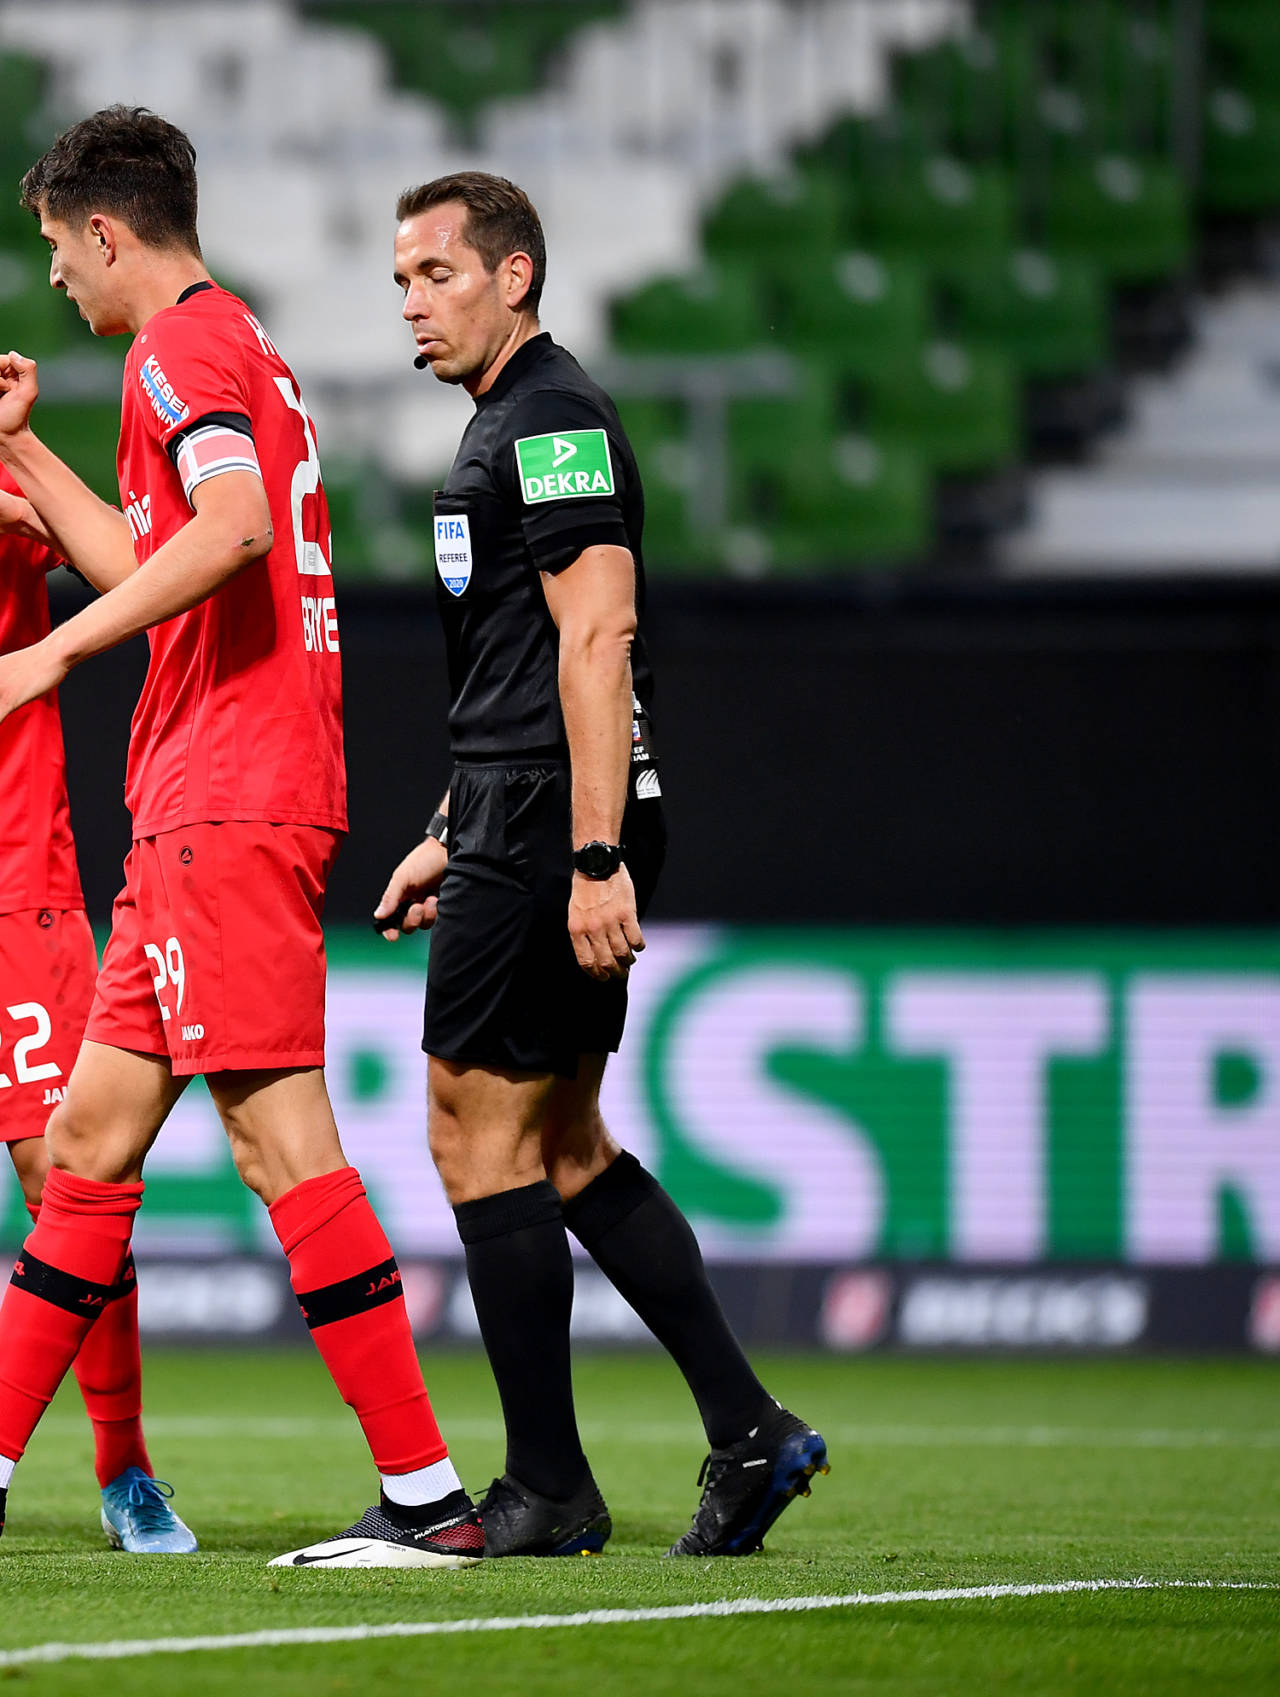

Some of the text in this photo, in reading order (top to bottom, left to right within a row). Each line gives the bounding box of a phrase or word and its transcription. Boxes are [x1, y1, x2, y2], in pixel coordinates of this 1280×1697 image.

[139, 370, 178, 433] TRAININ
[272, 377, 333, 575] 2
[525, 470, 610, 498] DEKRA
[437, 521, 465, 539] FIFA
[439, 552, 468, 563] REFEREE
[301, 596, 340, 653] BAYE
[144, 936, 186, 1021] 29
[42, 1085, 68, 1105] JA
[365, 1270, 401, 1297] JAK
